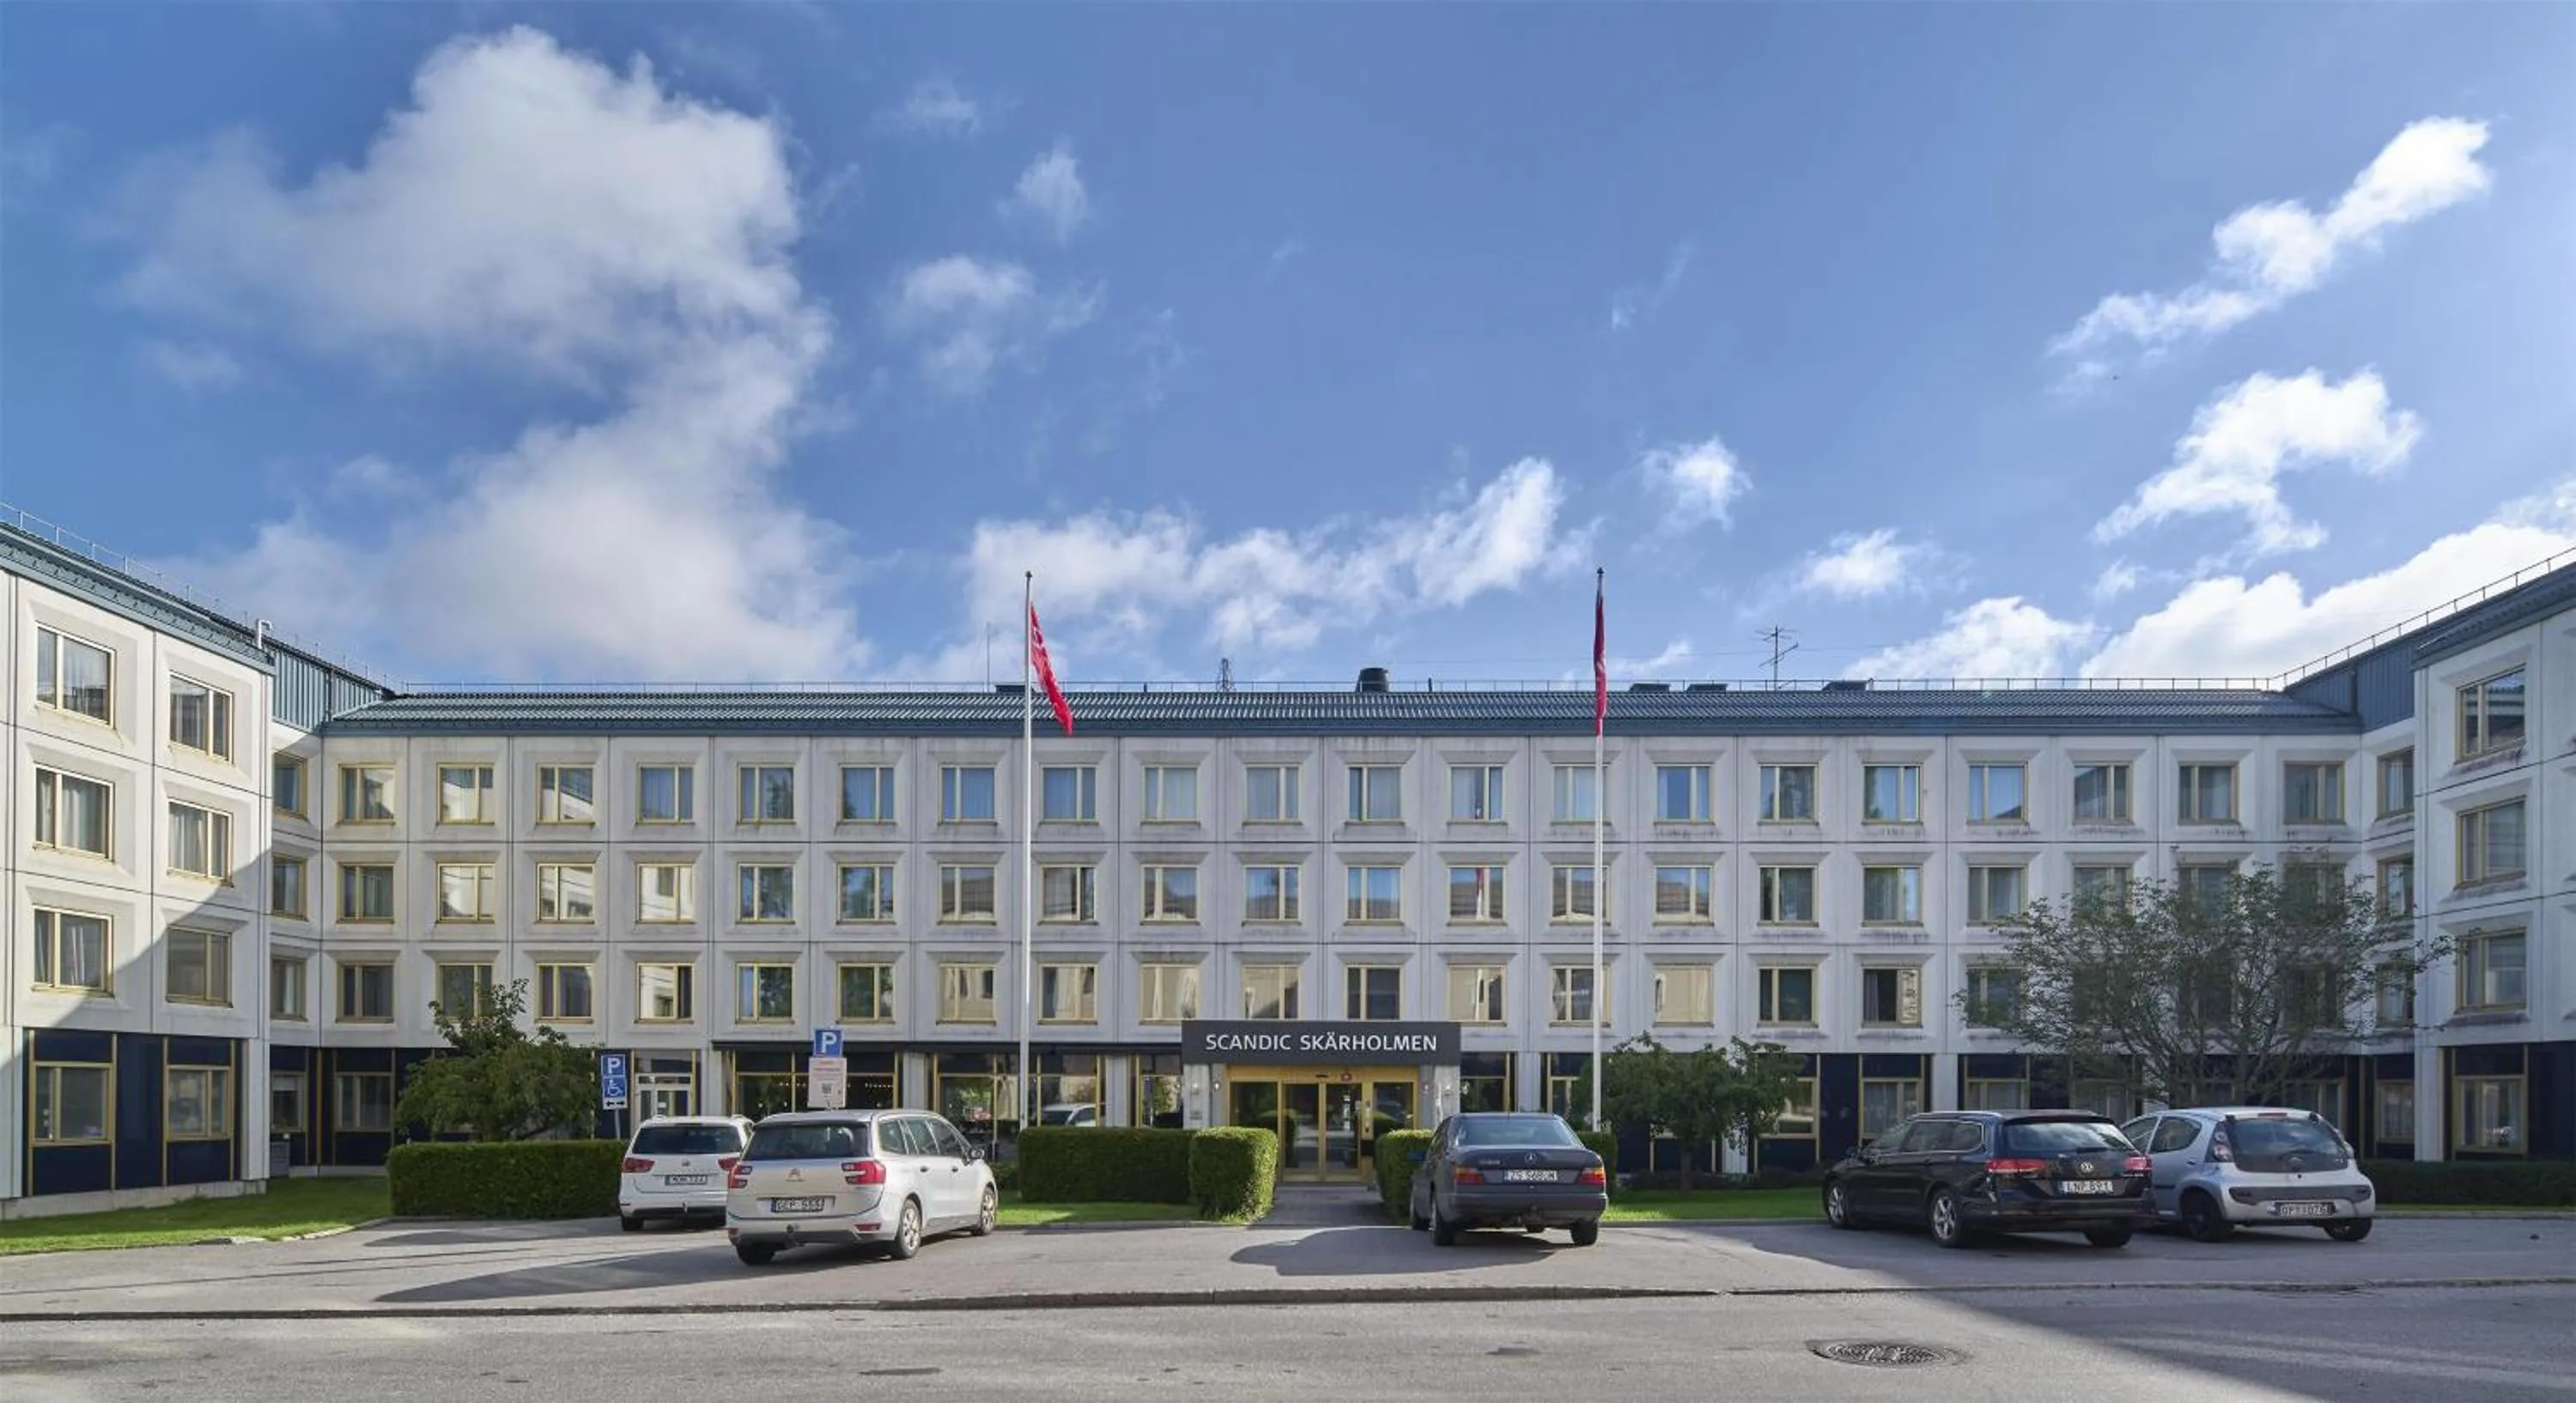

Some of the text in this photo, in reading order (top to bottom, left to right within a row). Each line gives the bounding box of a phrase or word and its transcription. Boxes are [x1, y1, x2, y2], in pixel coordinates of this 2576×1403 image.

[821, 1031, 837, 1053] P
[1205, 1031, 1437, 1052] SCANDIC SKÄRHOLMEN
[608, 1057, 621, 1073] P
